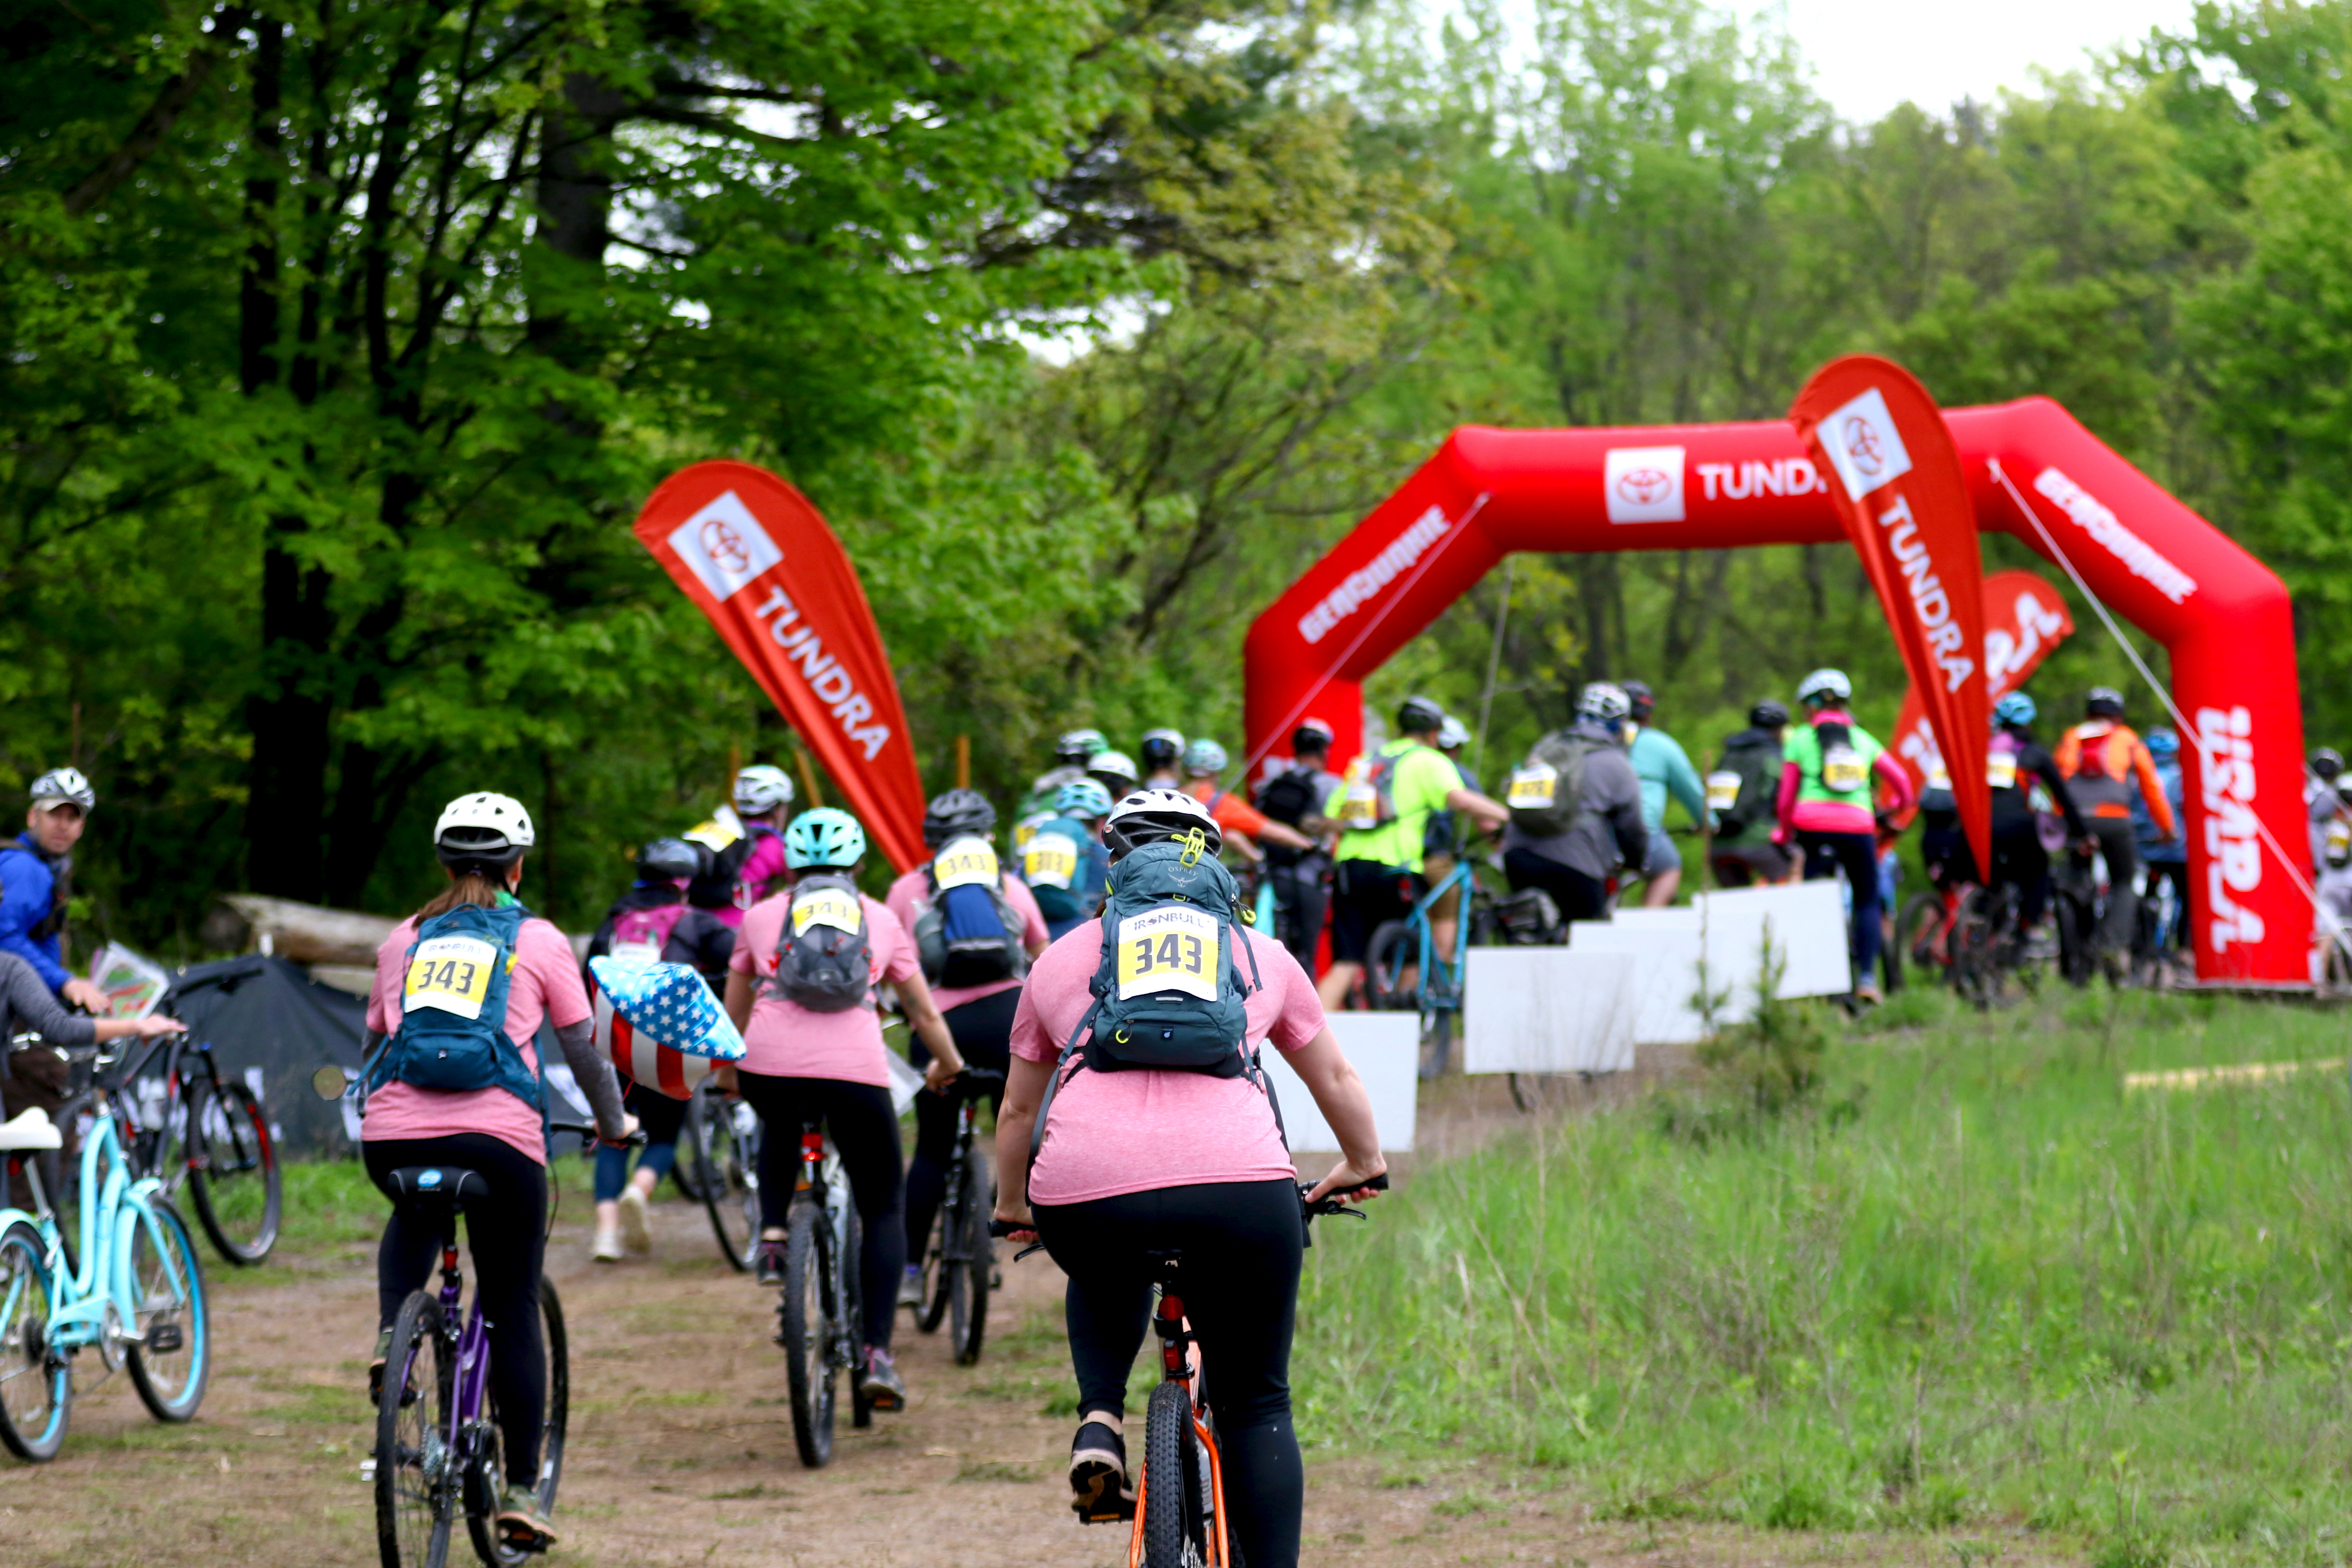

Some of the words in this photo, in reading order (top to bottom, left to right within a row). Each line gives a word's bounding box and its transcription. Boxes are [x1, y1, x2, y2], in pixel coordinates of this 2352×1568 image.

[1696, 457, 1828, 500] TUND
[1878, 493, 1974, 693] TUNDRA
[755, 585, 890, 762] TUNDRA
[1168, 867, 1198, 876] OSPREY
[1135, 934, 1201, 975] 343
[417, 961, 475, 995] 343
